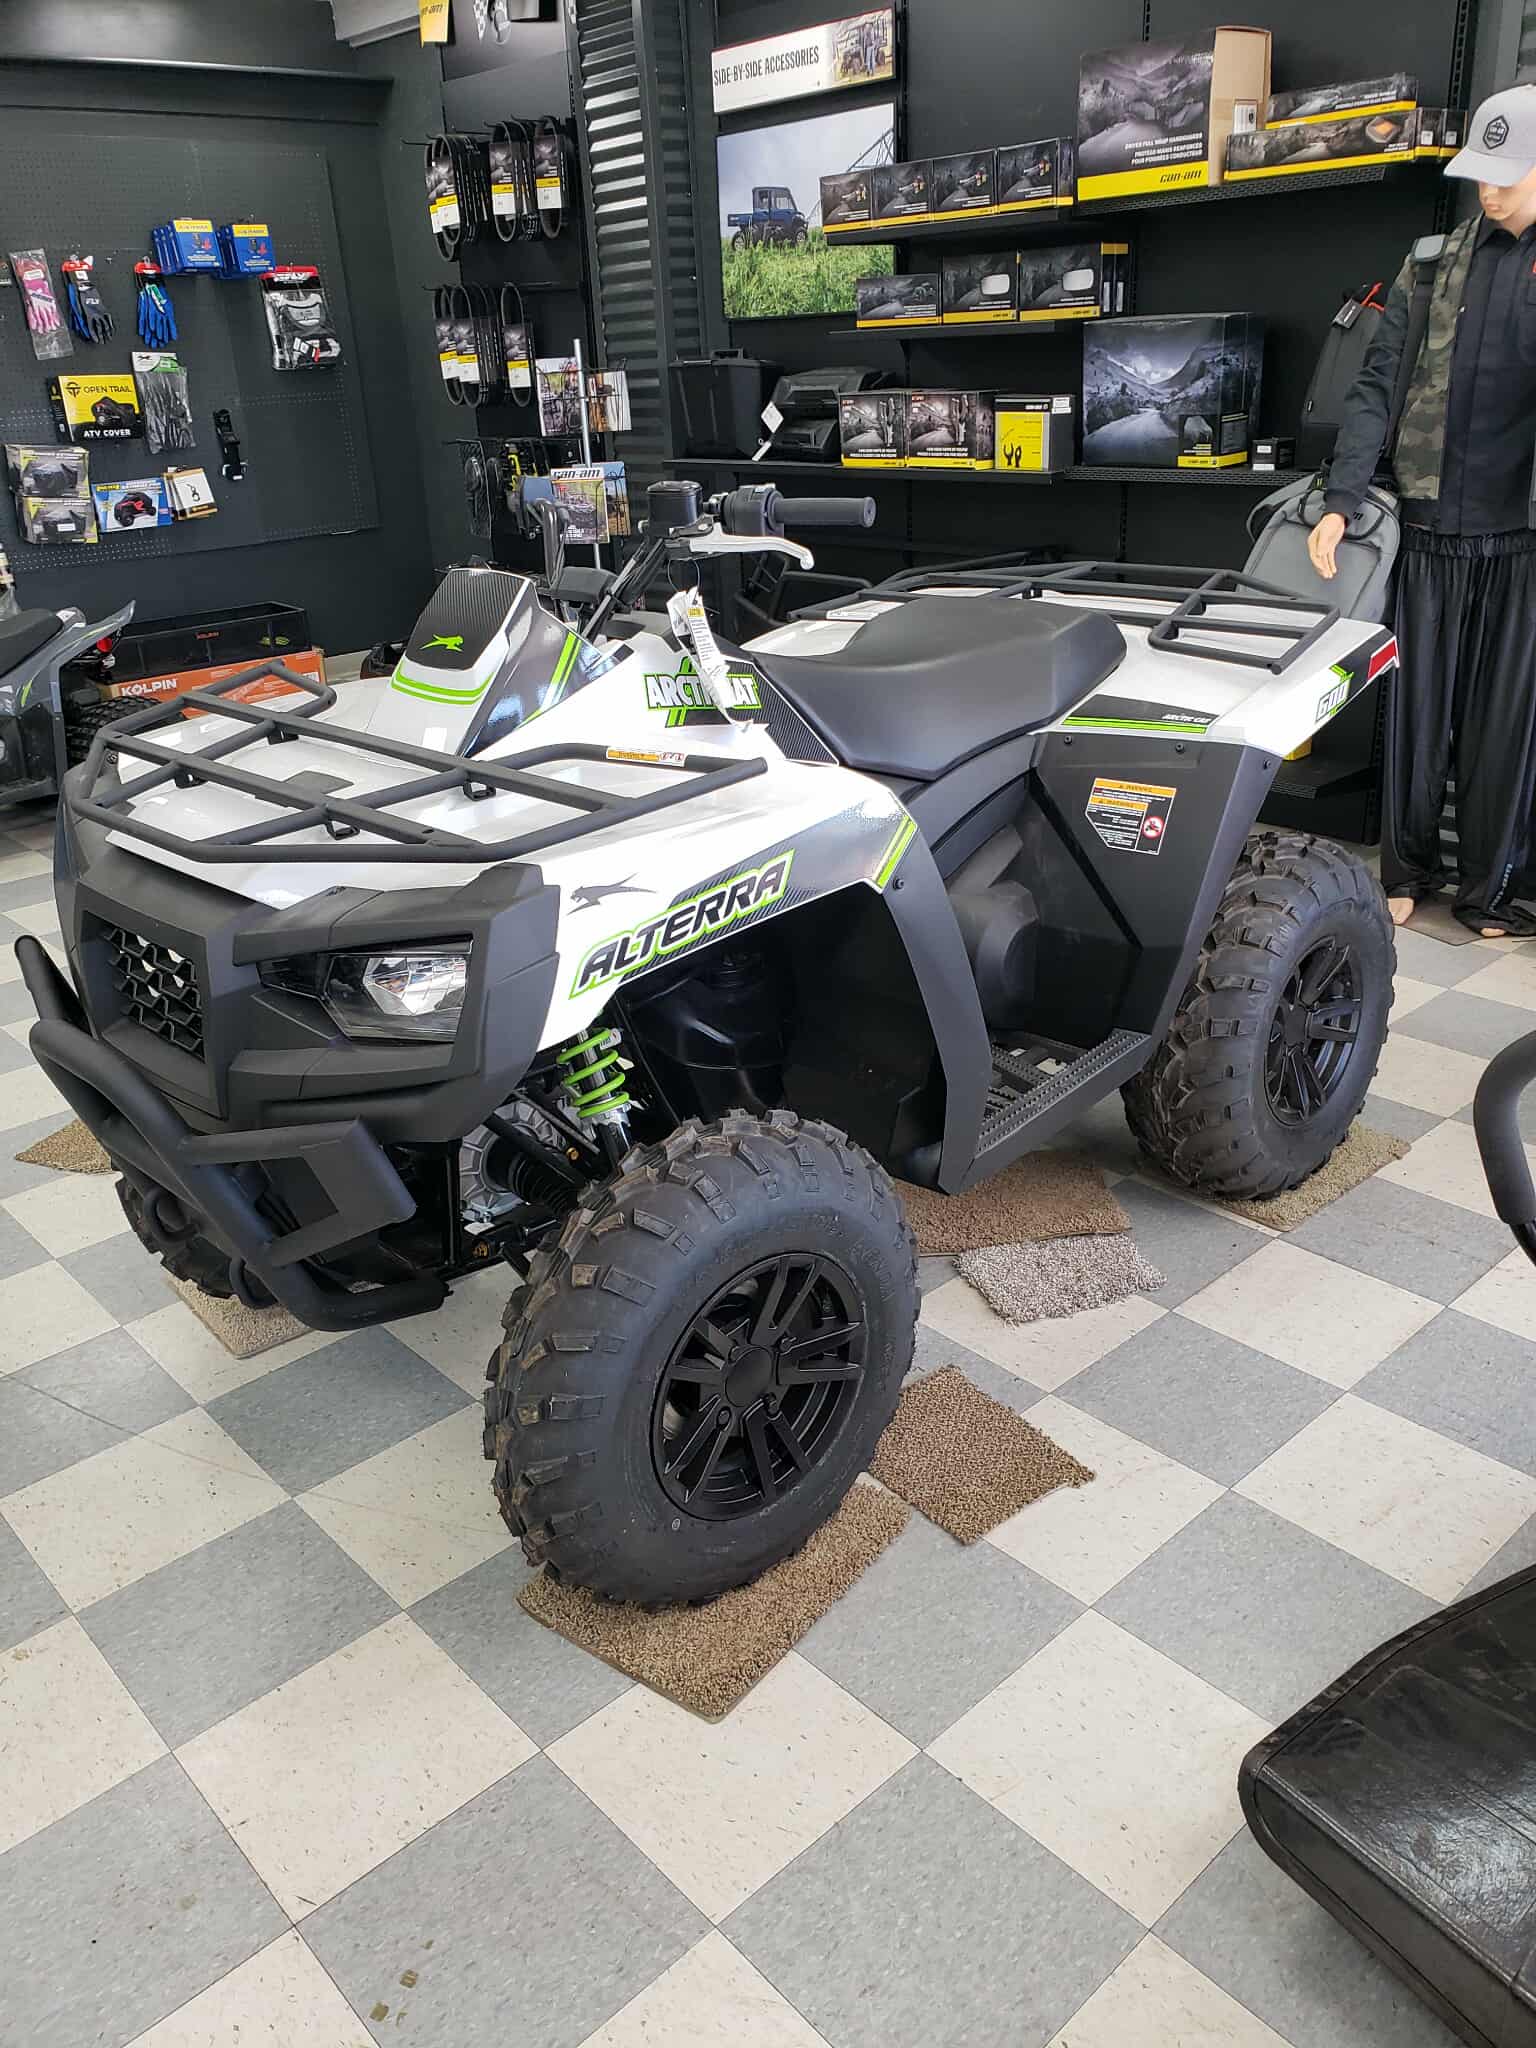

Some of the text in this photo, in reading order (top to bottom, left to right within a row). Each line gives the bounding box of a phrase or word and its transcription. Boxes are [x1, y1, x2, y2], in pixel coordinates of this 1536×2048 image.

[713, 45, 820, 86] SIDE-BY-SIDE ACCESSORIES
[83, 385, 132, 394] OPEN TRAIL
[84, 429, 131, 438] ATV COVER
[121, 679, 177, 697] KOLPIN
[646, 675, 715, 707] ARCTI
[577, 860, 787, 988] ALTERRA
